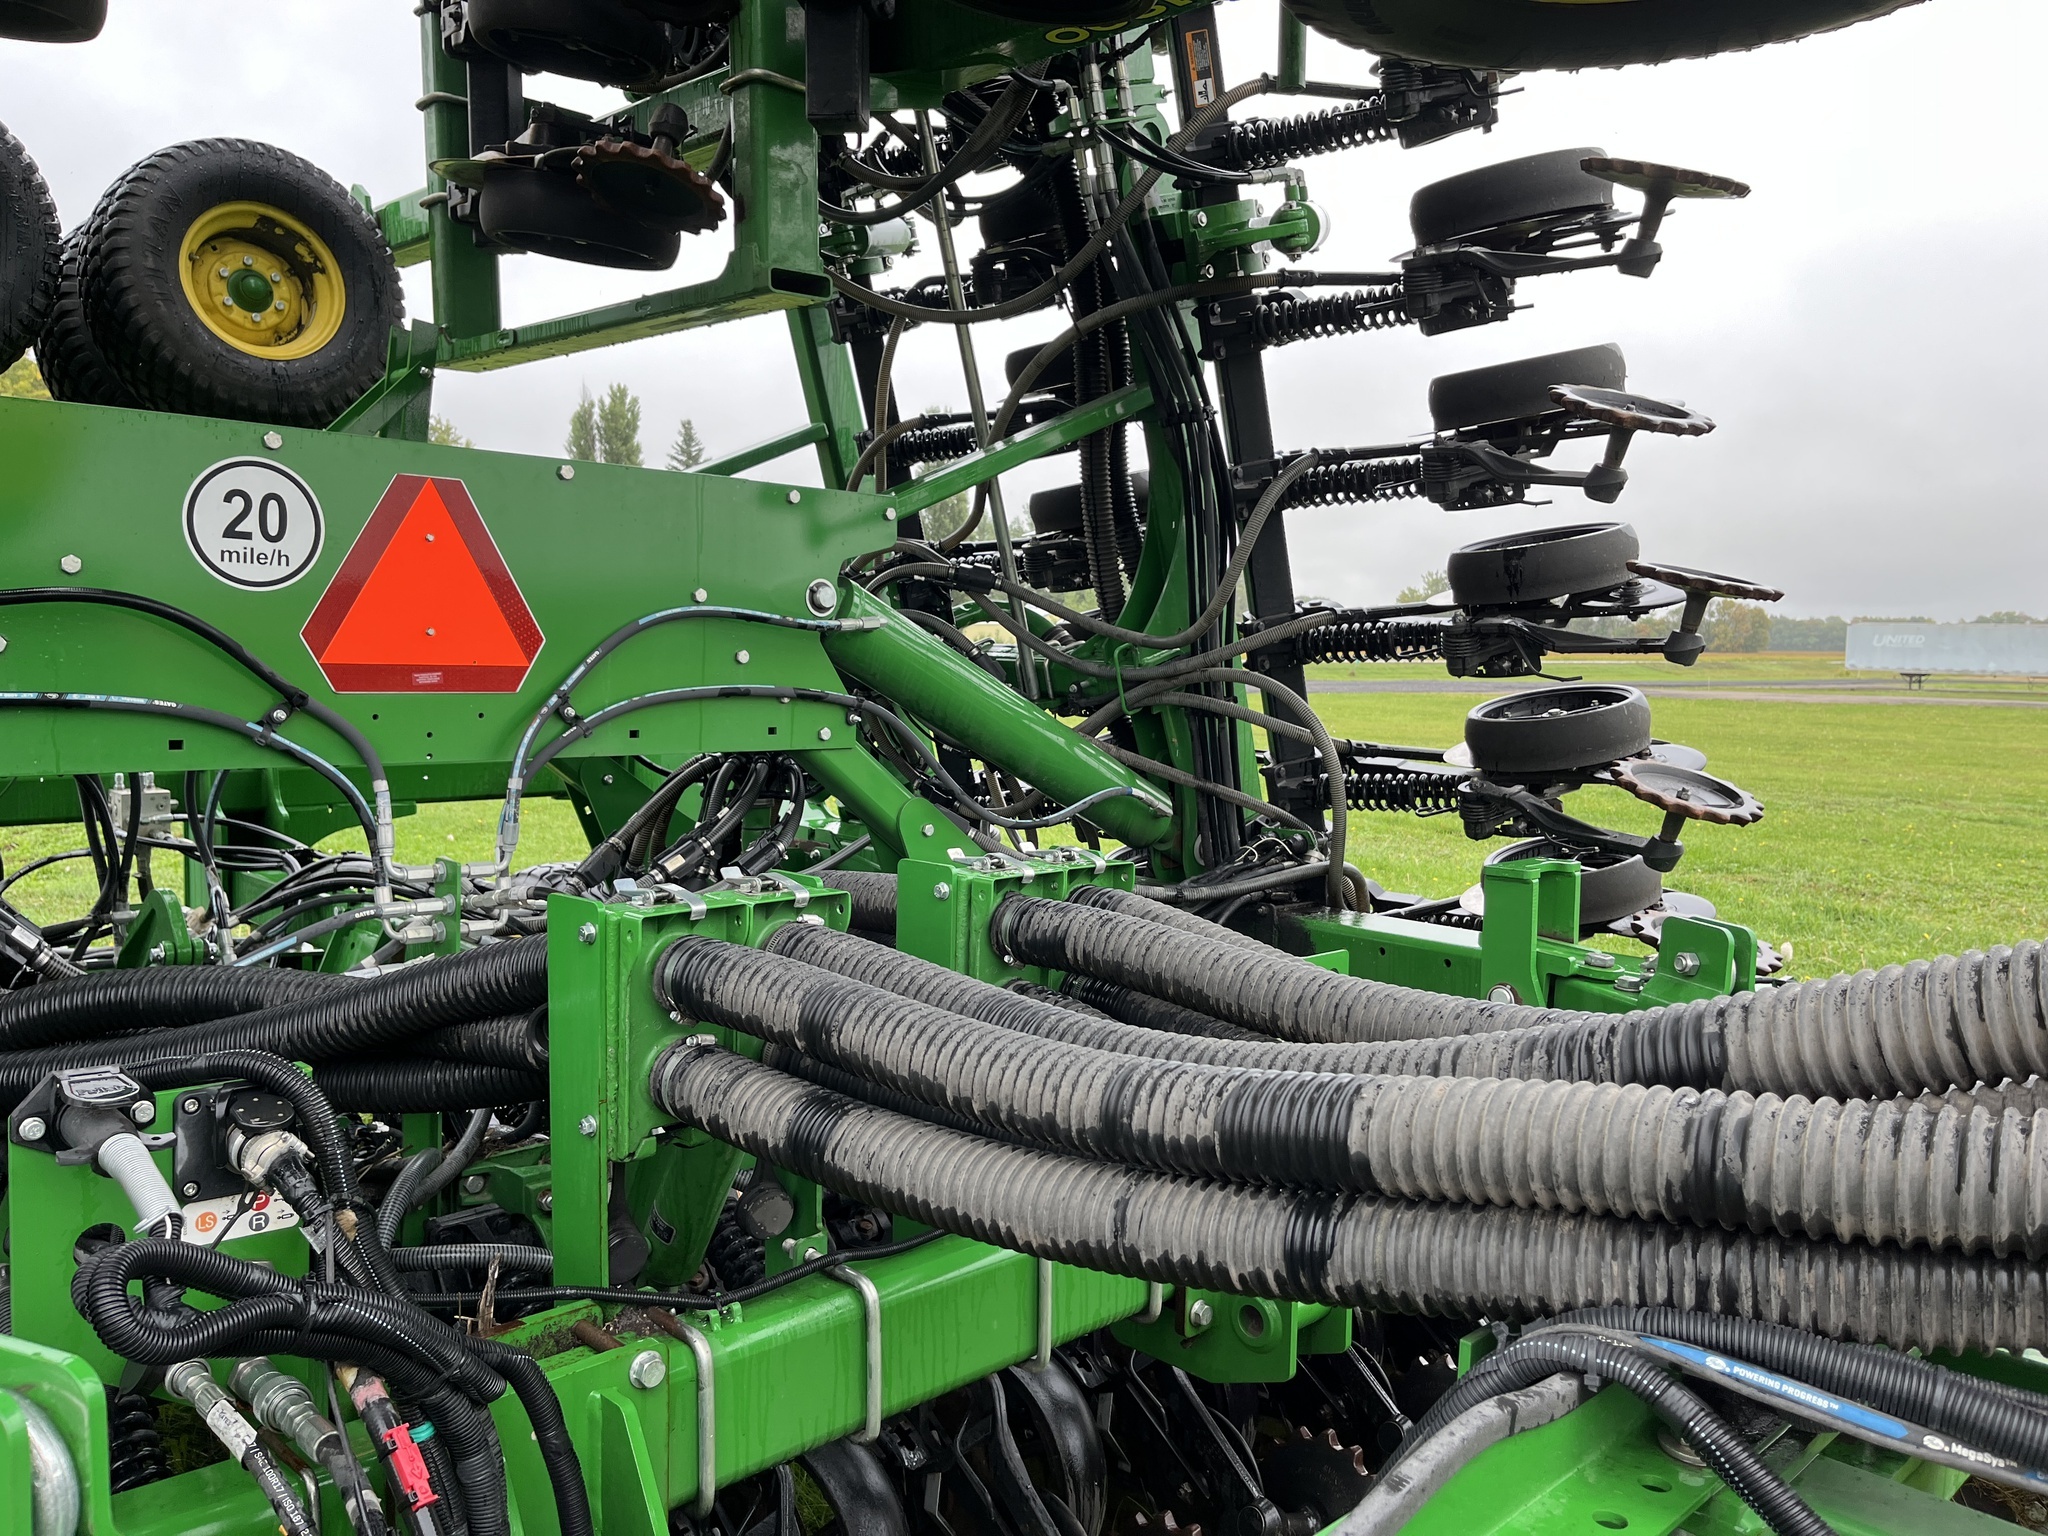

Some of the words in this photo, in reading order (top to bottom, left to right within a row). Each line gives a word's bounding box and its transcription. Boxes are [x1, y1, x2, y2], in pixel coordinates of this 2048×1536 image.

[222, 488, 288, 543] 20
[220, 547, 290, 567] mile/h
[1873, 634, 1926, 647] UNITED
[354, 910, 376, 919] GATES
[198, 1215, 214, 1229] LS
[253, 1215, 266, 1228] R
[1733, 1366, 1781, 1390] POWERING
[254, 1451, 268, 1467] SAE
[262, 1466, 284, 1495] 100R17
[281, 1497, 295, 1512] ISO
